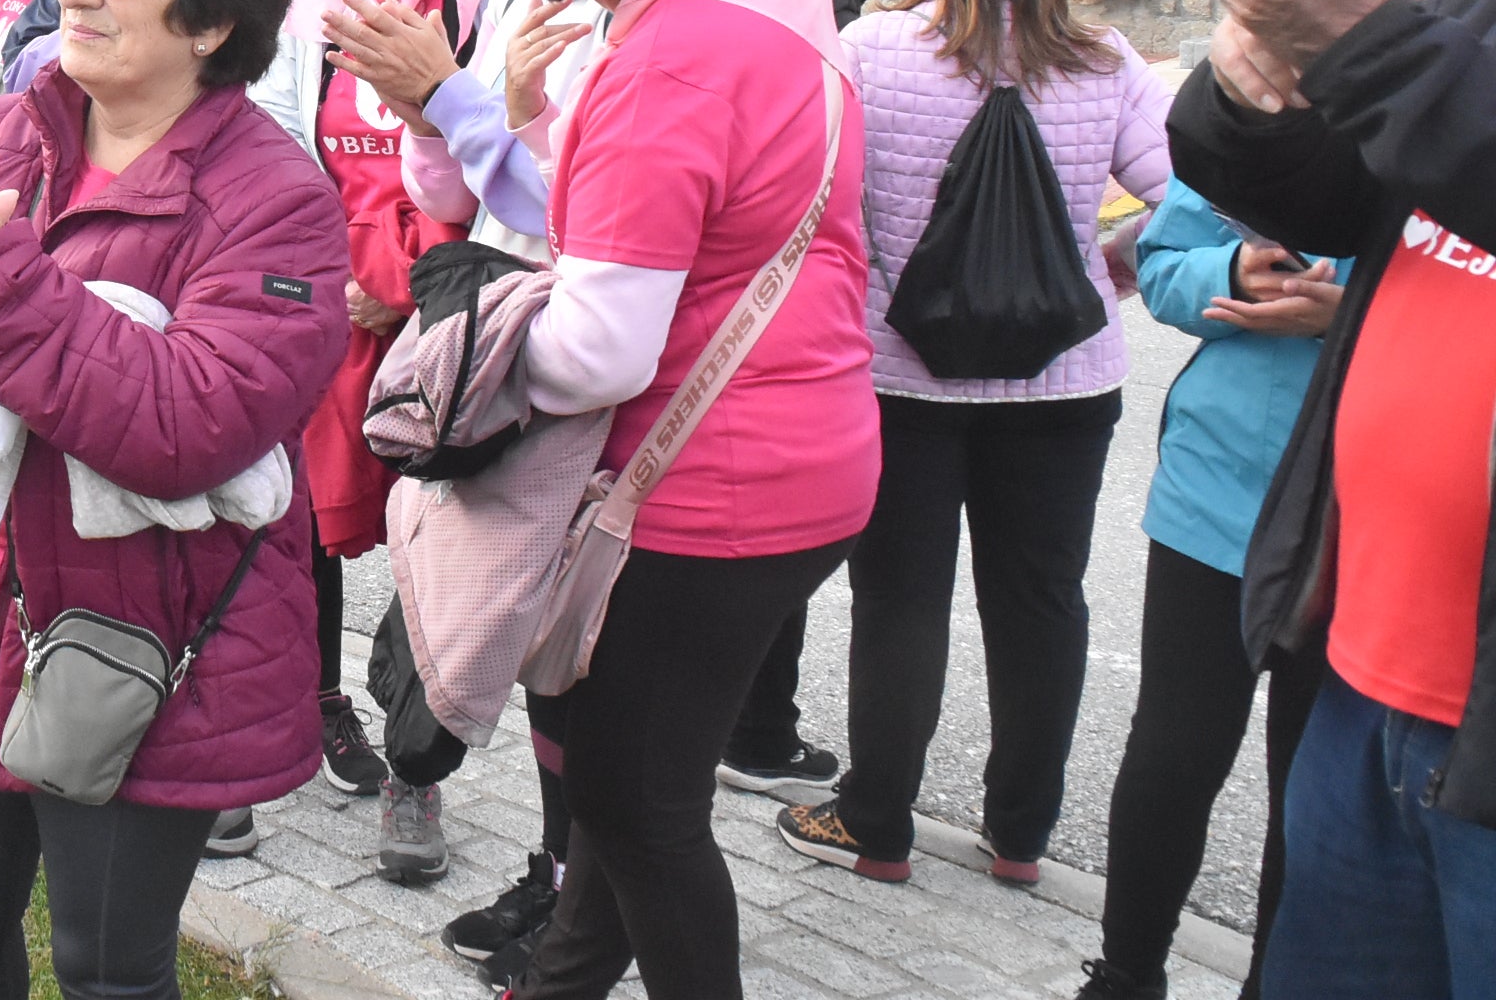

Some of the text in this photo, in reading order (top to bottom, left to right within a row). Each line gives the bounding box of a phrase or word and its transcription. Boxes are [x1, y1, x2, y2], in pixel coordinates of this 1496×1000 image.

[340, 134, 401, 155] BÉJ
[273, 282, 302, 294] FORCLAZ
[656, 308, 756, 453] SKECHERS
